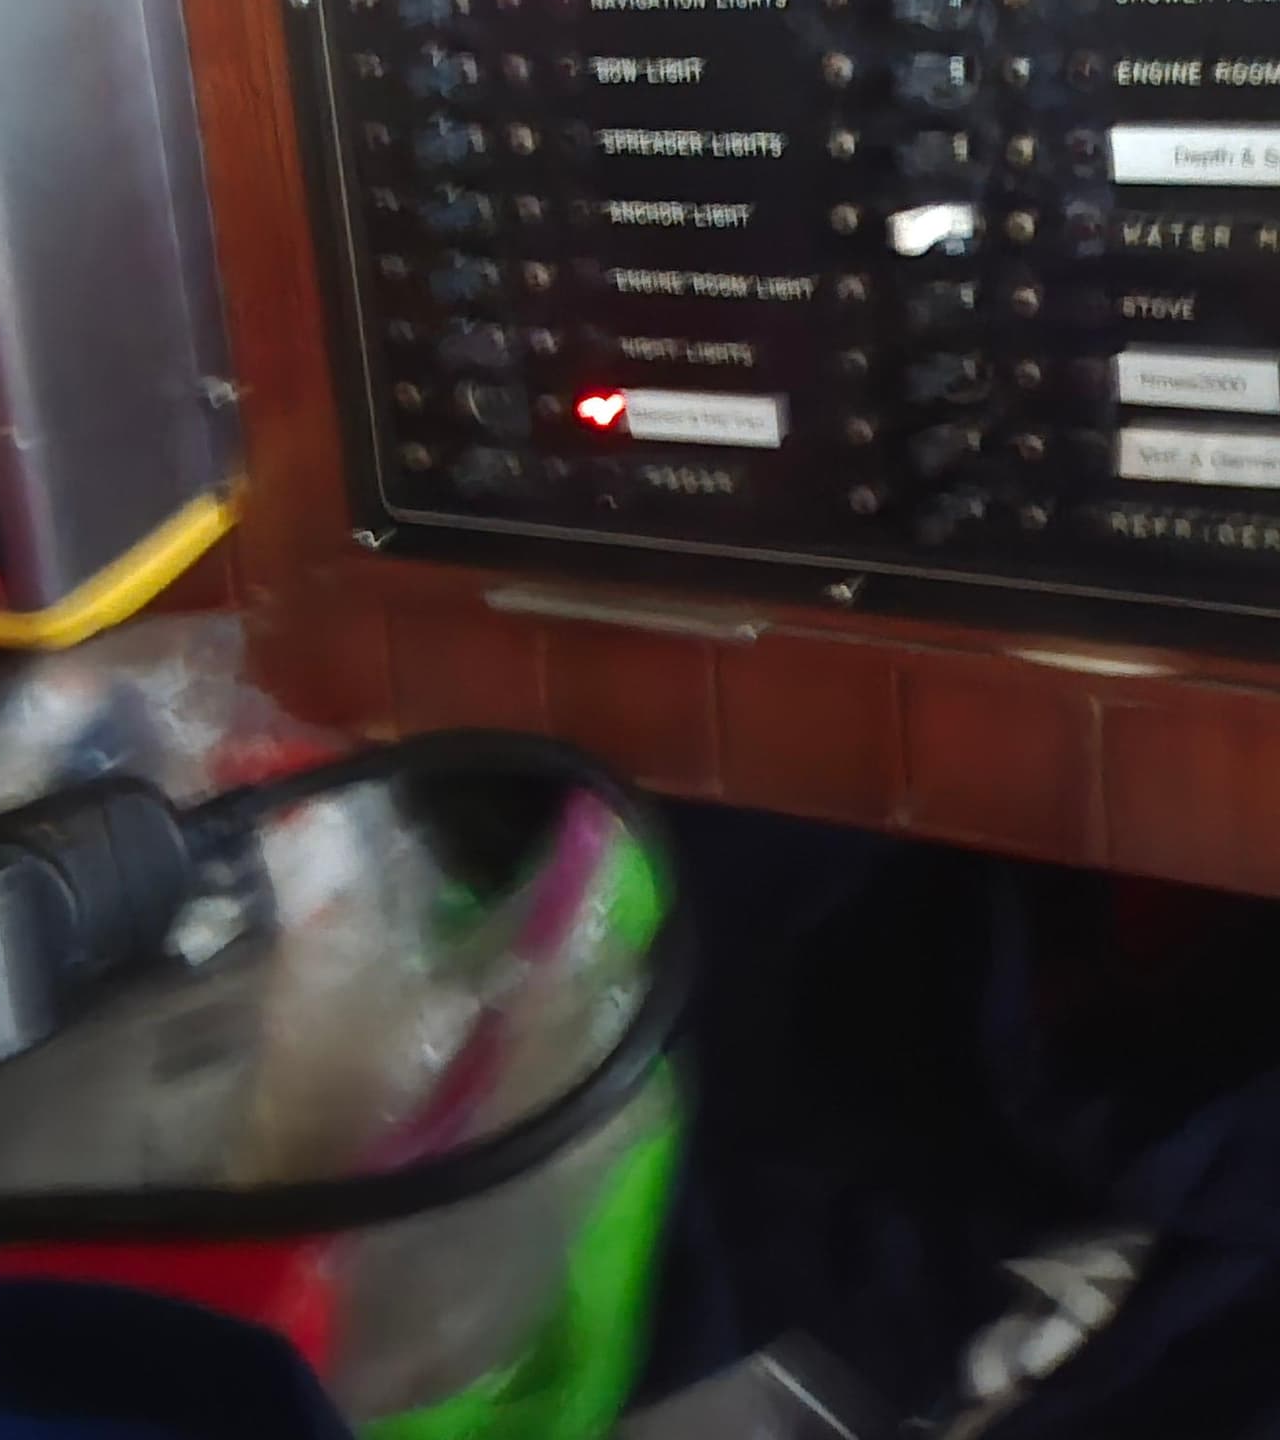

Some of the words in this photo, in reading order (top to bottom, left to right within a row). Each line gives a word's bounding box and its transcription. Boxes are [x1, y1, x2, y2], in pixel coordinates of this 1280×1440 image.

[1114, 60, 1202, 88] ENGINE
[598, 129, 703, 157] SPREADER
[712, 131, 786, 158] LIGHTS
[1173, 145, 1234, 169] Depth
[605, 200, 686, 227] ANCHOR
[693, 202, 754, 229] LIGHT
[1122, 224, 1232, 252] WATER
[1122, 295, 1197, 321] STOVE
